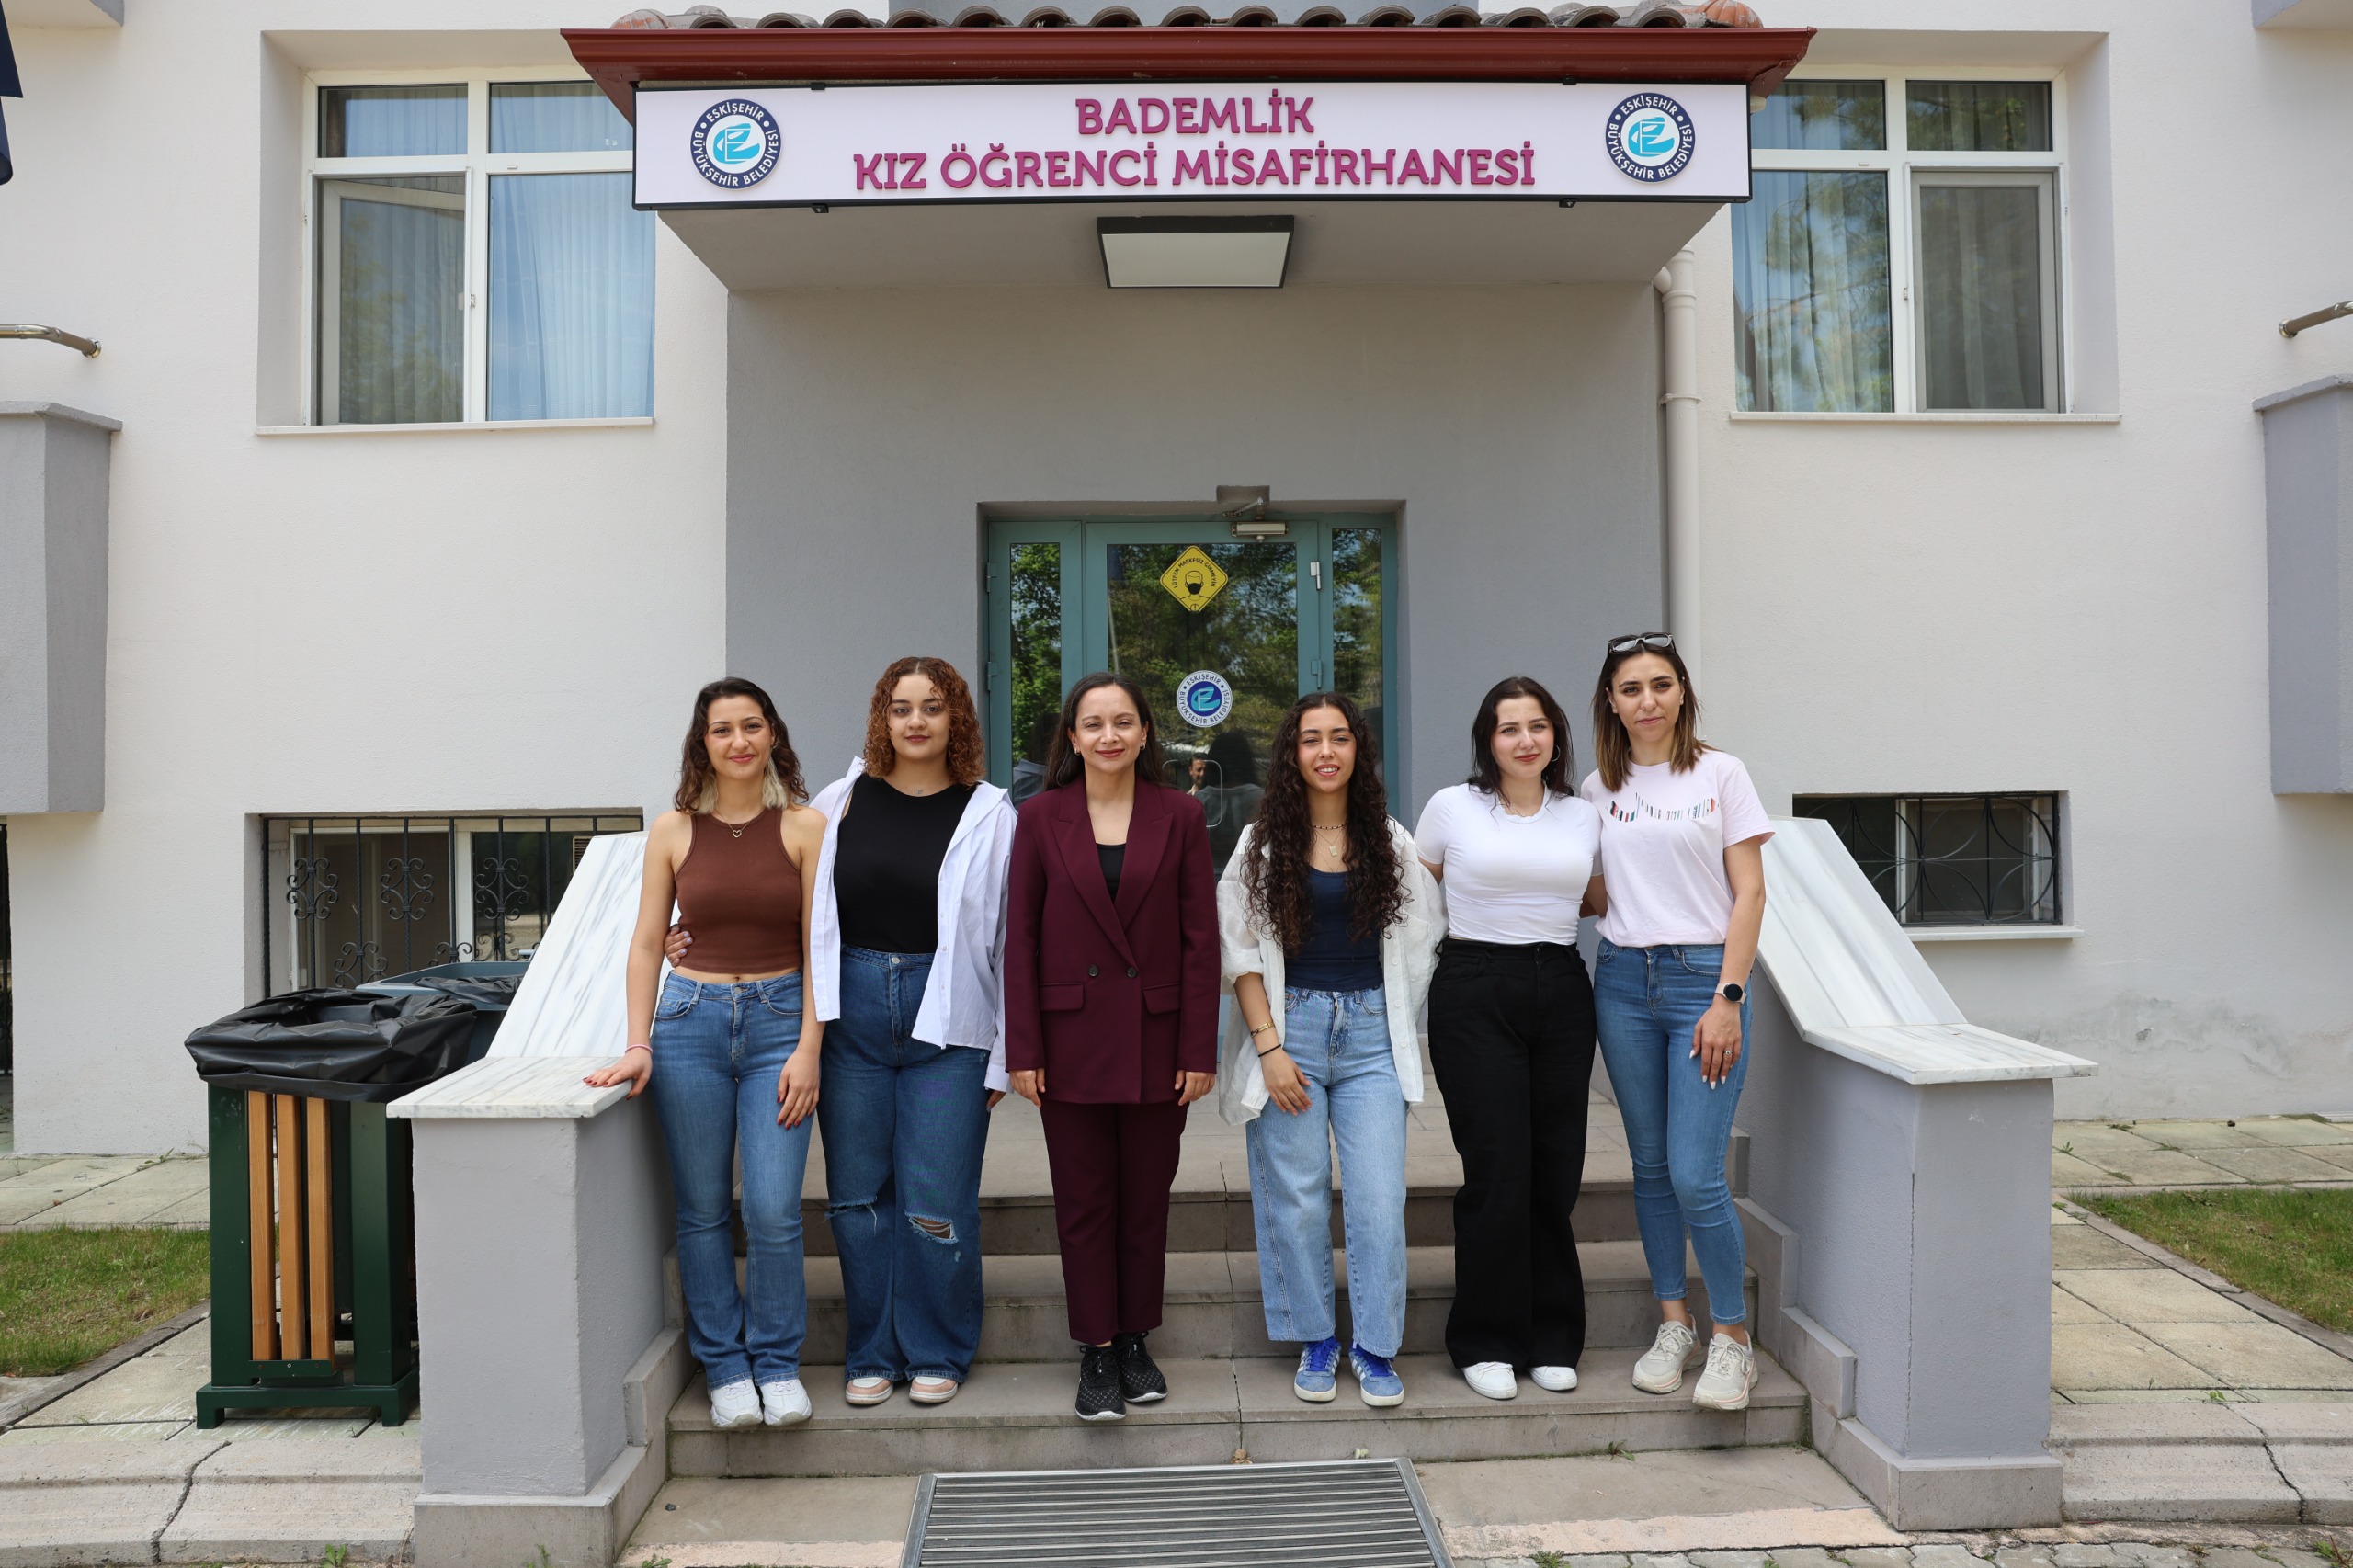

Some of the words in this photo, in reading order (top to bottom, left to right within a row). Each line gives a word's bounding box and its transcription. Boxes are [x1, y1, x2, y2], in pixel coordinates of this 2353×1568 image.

[706, 101, 765, 123] ESKİŞEHİR
[1075, 88, 1314, 135] BADEMLİK
[1620, 95, 1678, 116] ESKİŞEHİR
[692, 131, 739, 187] BÜYÜKŞEHİR
[743, 129, 779, 185] BELEDİYESİ
[853, 153, 926, 189] KIZ
[939, 142, 1158, 188] ÖĞRENCİ
[1172, 140, 1536, 186] MİSAFİRHANESİ
[1608, 122, 1654, 179] BÜYÜKŞEHİR
[1658, 124, 1693, 178] BELEDİYESİ
[1178, 557, 1205, 569] MASKESİZ
[1204, 562, 1217, 587] GİRMEYİN
[1186, 673, 1222, 686] ESKİŞEHİR
[1178, 691, 1208, 724] BÜYÜKŞEHİR
[1210, 689, 1230, 723] BELEDİYESİ
